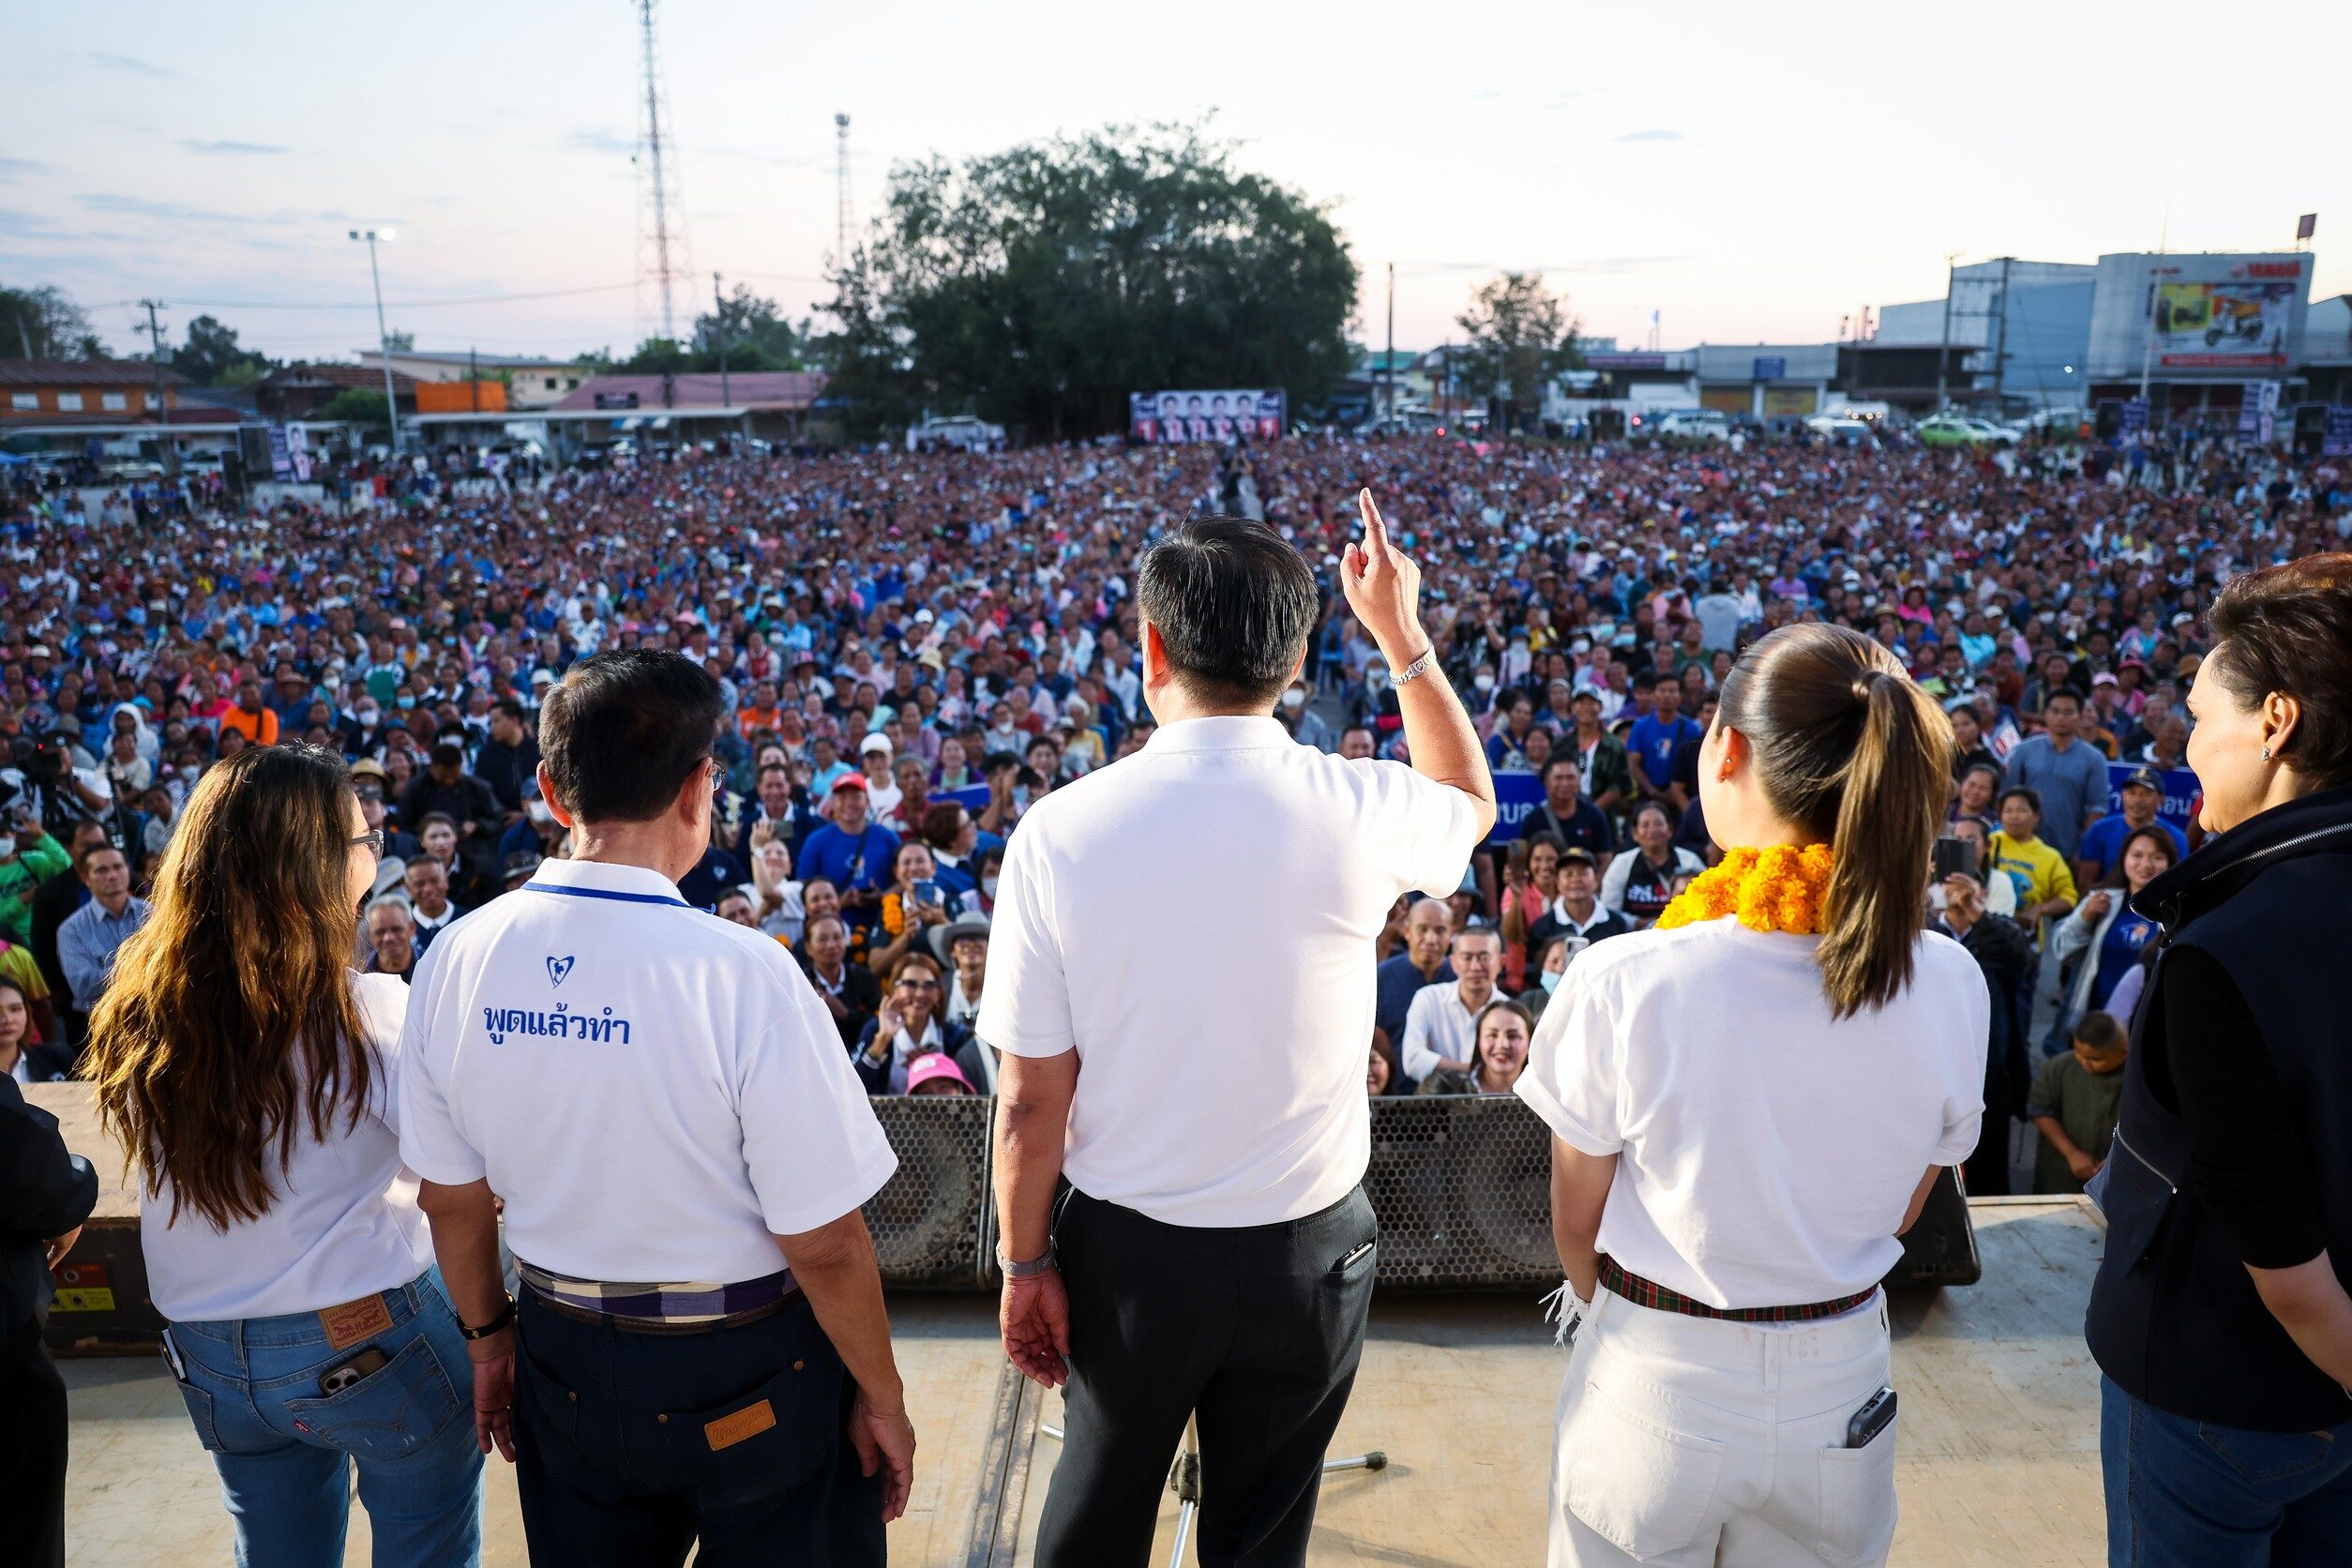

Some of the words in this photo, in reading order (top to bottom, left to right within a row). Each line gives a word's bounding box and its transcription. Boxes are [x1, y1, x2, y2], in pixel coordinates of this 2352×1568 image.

[484, 1002, 630, 1045] พูดแล้วทำ
[713, 1410, 765, 1442] Wrangler
